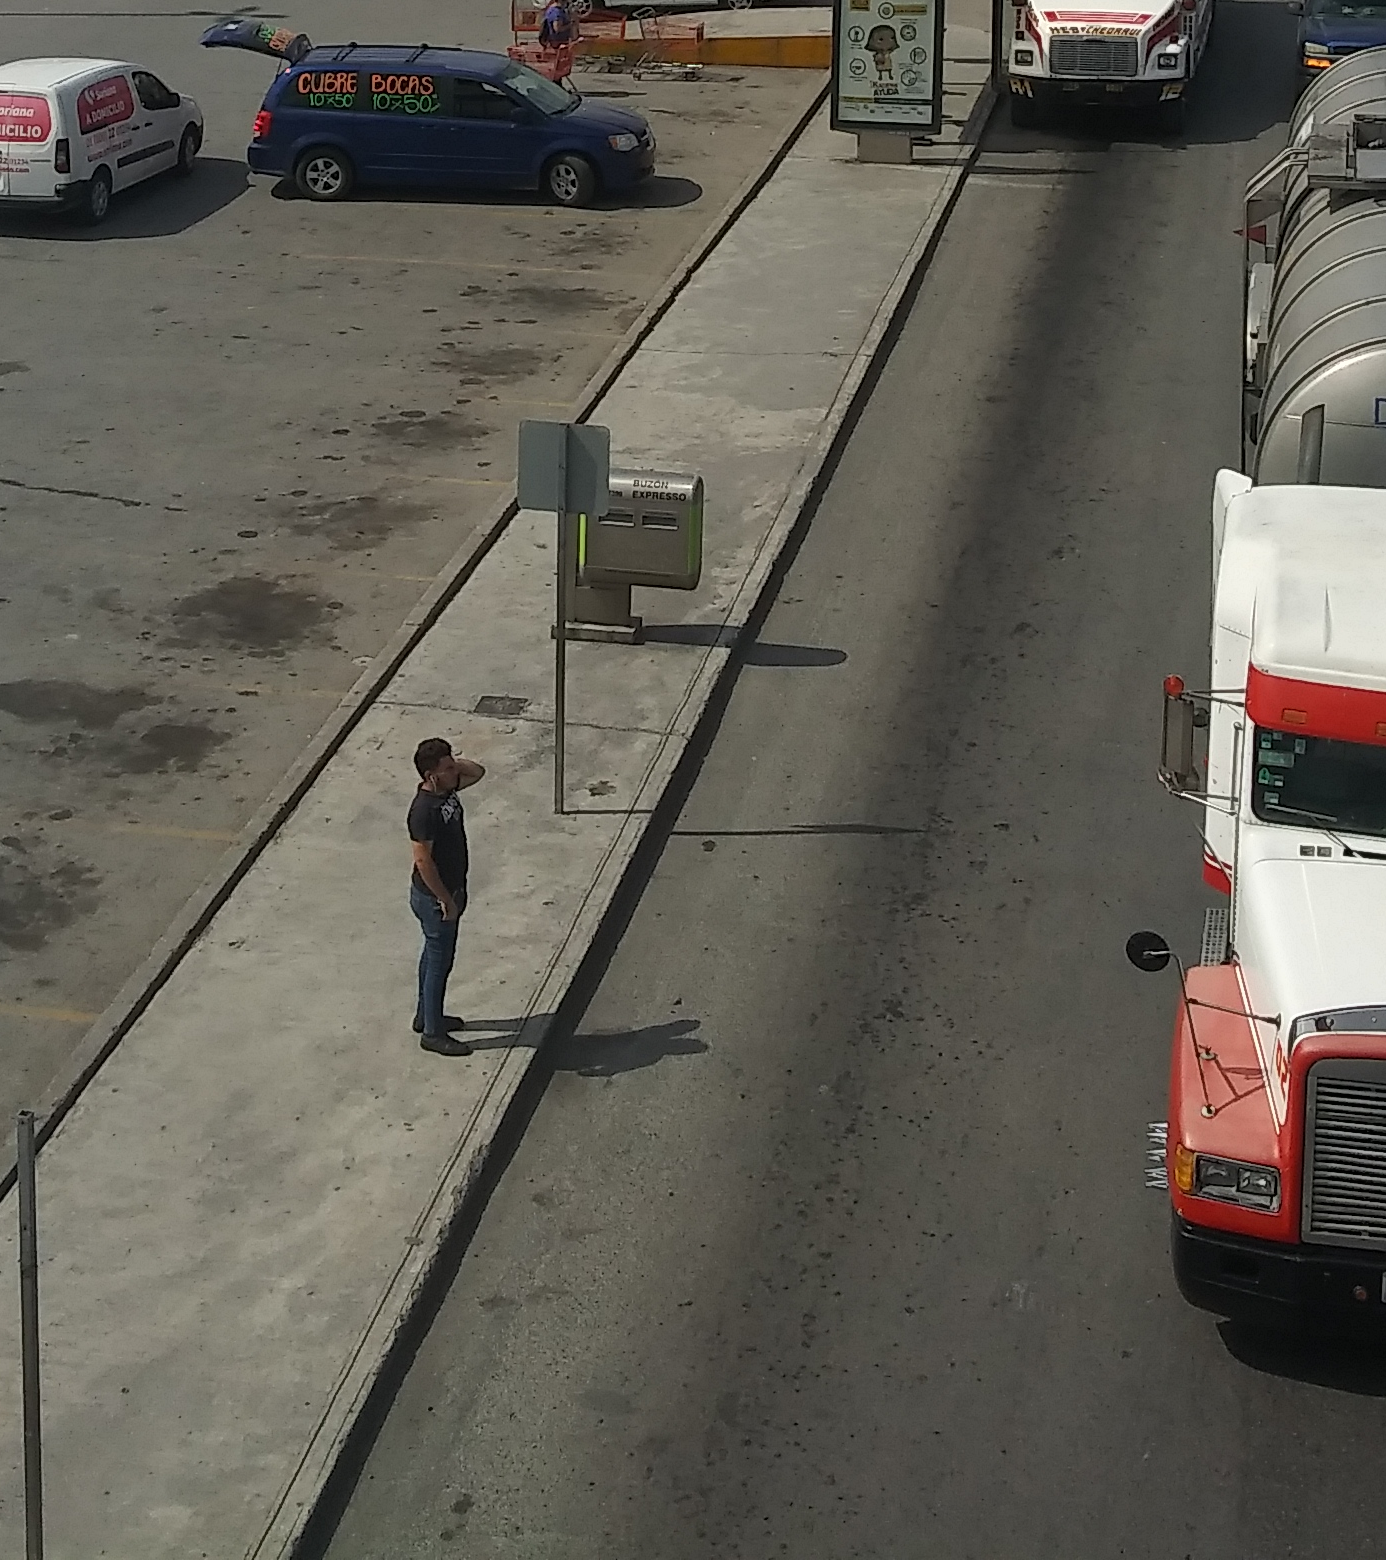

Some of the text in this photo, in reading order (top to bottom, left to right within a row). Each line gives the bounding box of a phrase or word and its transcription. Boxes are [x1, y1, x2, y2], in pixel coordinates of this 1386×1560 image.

[1049, 26, 1079, 35] HEB
[297, 72, 434, 95] CUBRE BOCAS
[92, 101, 125, 122] DOMICILIO
[632, 490, 687, 502] EXPRESSO
